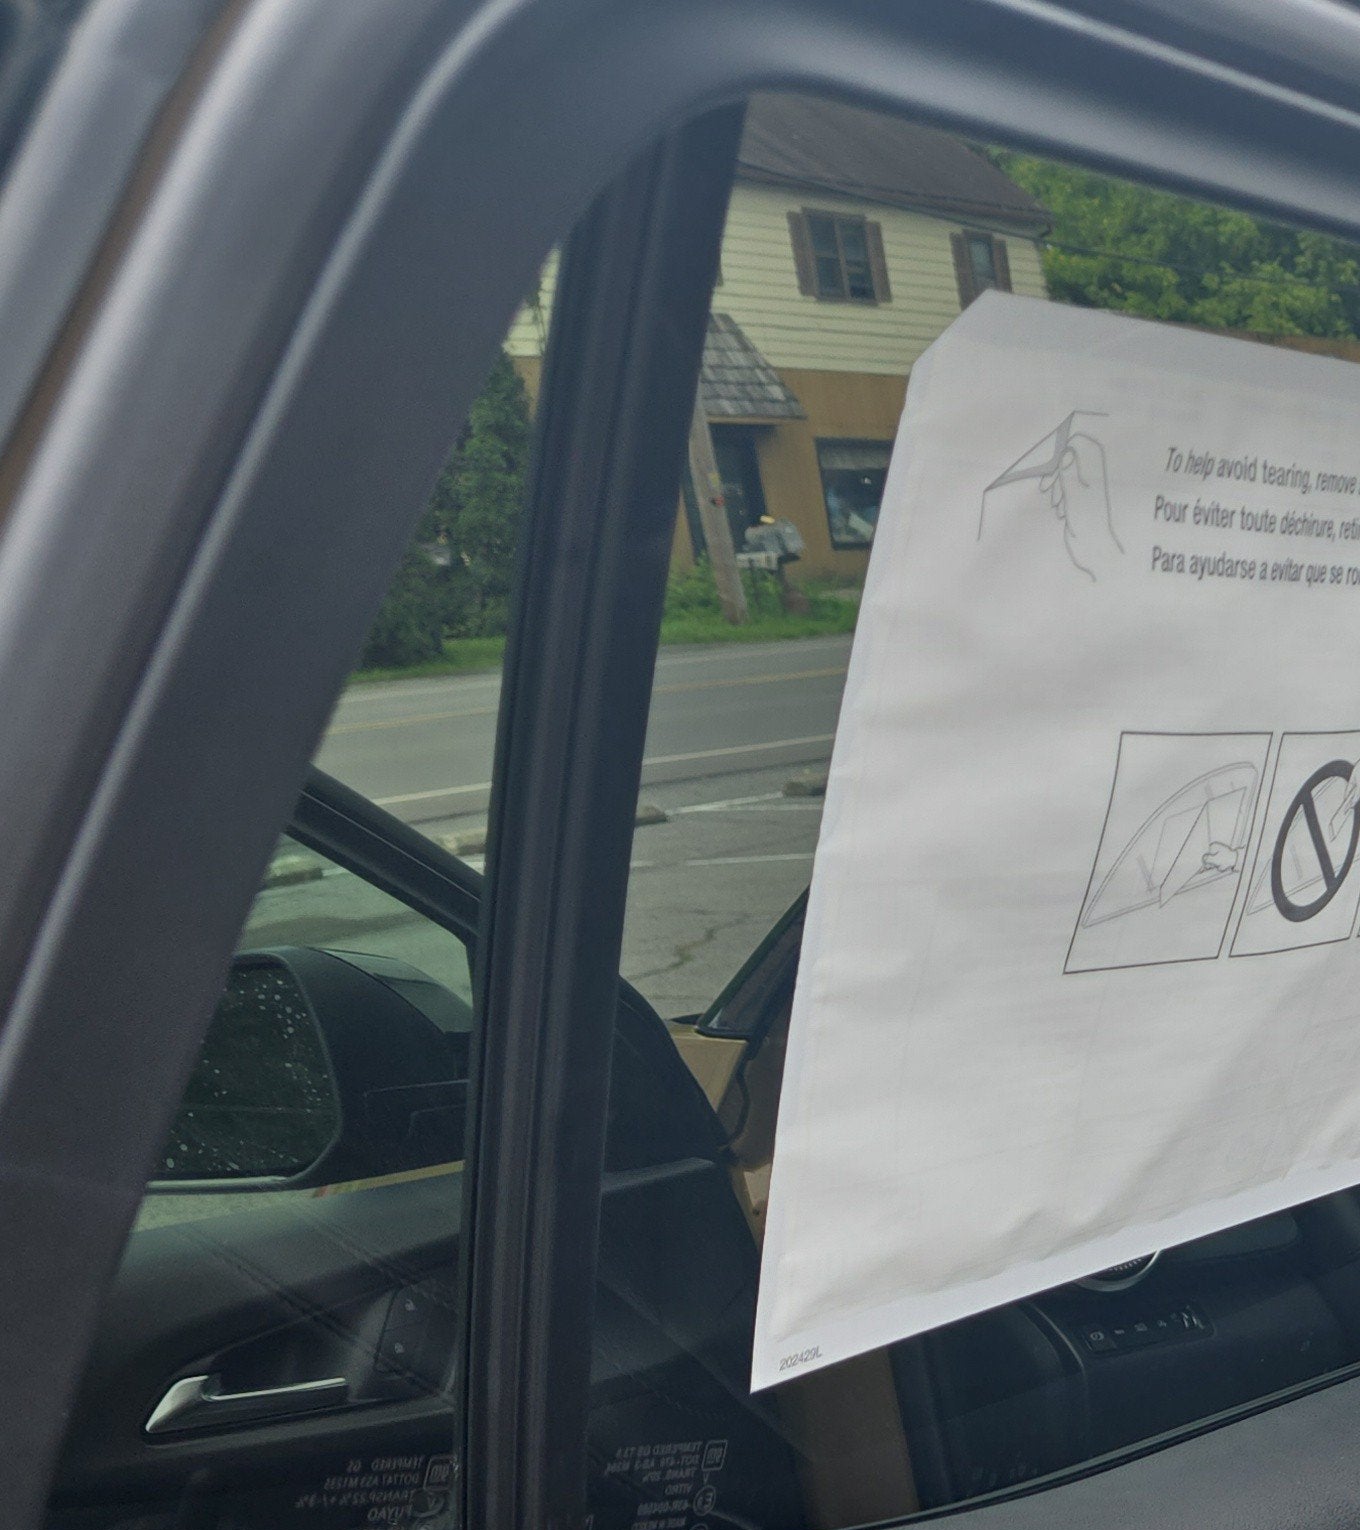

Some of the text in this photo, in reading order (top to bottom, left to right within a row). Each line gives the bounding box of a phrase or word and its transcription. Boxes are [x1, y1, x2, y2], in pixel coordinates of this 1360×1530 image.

[1166, 447, 1183, 472] To
[1184, 450, 1215, 481] help
[1216, 455, 1257, 482] avoid
[1262, 459, 1312, 494] tearing,
[1315, 472, 1357, 494] remove
[1154, 494, 1188, 523] Pour
[1193, 497, 1236, 528] éviter
[1240, 505, 1276, 534] toute
[1152, 545, 1185, 574] Para
[1189, 551, 1256, 581] ayudarse
[1259, 560, 1268, 581] a
[1271, 557, 1304, 582] evitar
[1306, 563, 1327, 587] que
[1330, 564, 1343, 584] se
